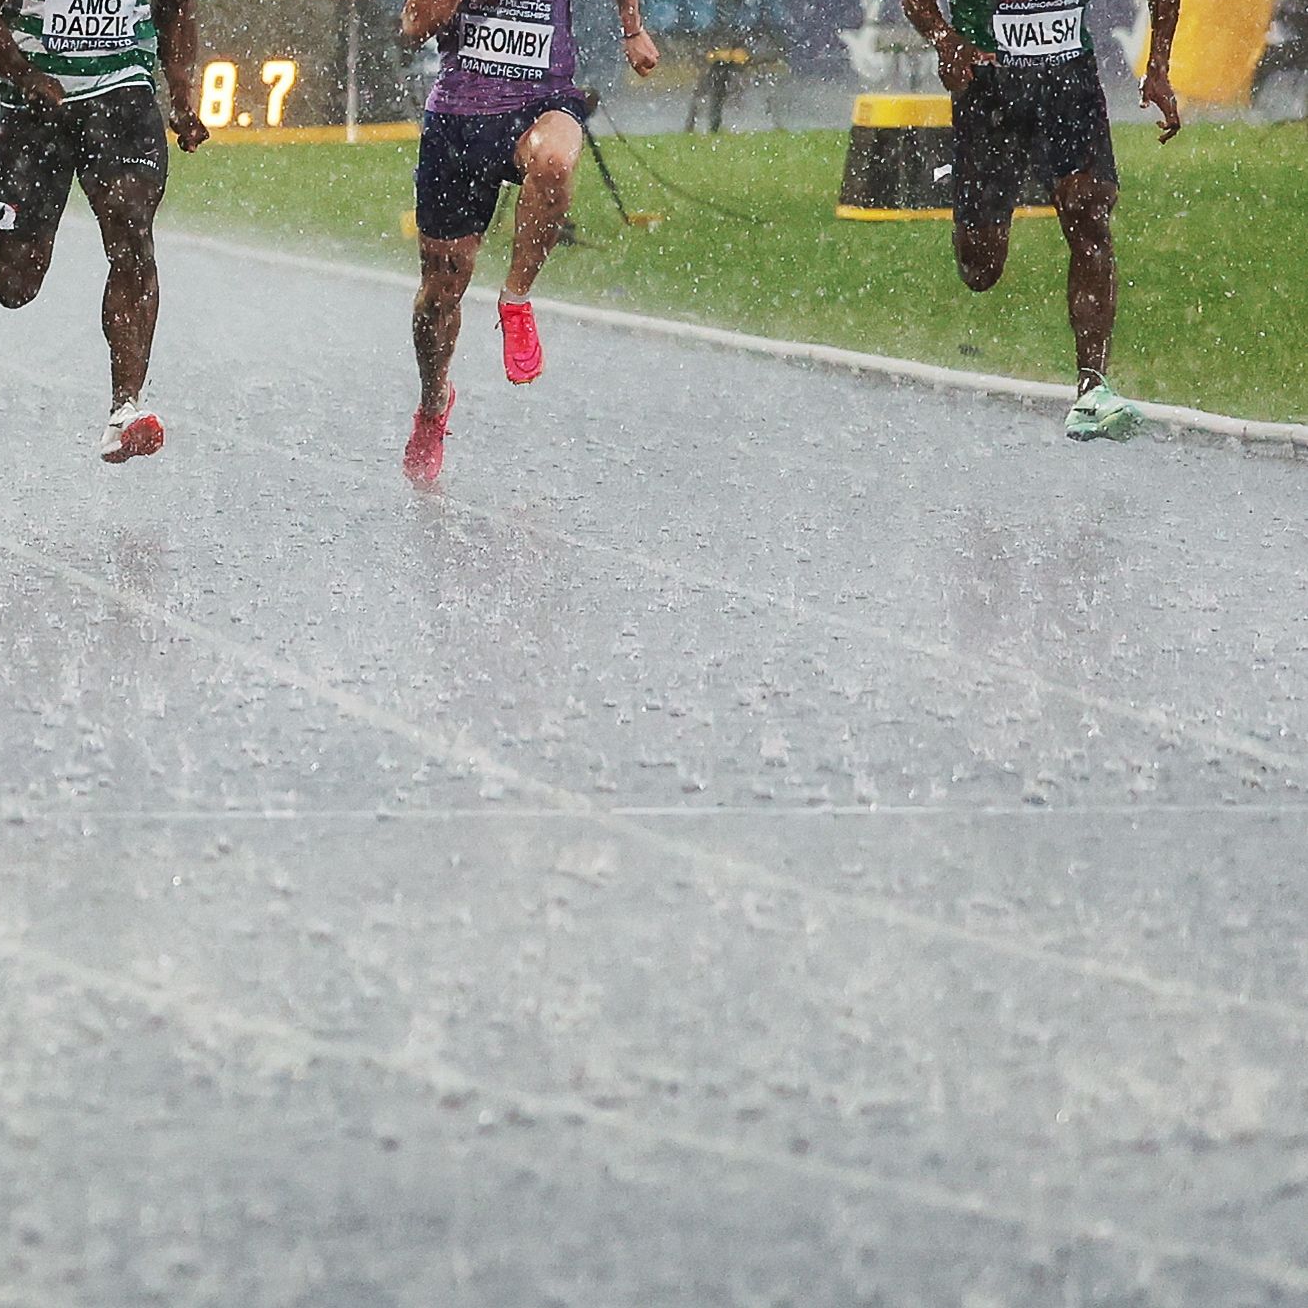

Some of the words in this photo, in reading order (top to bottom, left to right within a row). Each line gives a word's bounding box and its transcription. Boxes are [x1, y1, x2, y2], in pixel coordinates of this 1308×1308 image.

[51, 13, 129, 37] DADZIE
[463, 22, 550, 59] BROMBY
[1001, 16, 1077, 48] WALSH
[461, 59, 543, 80] MANCHESTER
[199, 58, 298, 128] 8.7
